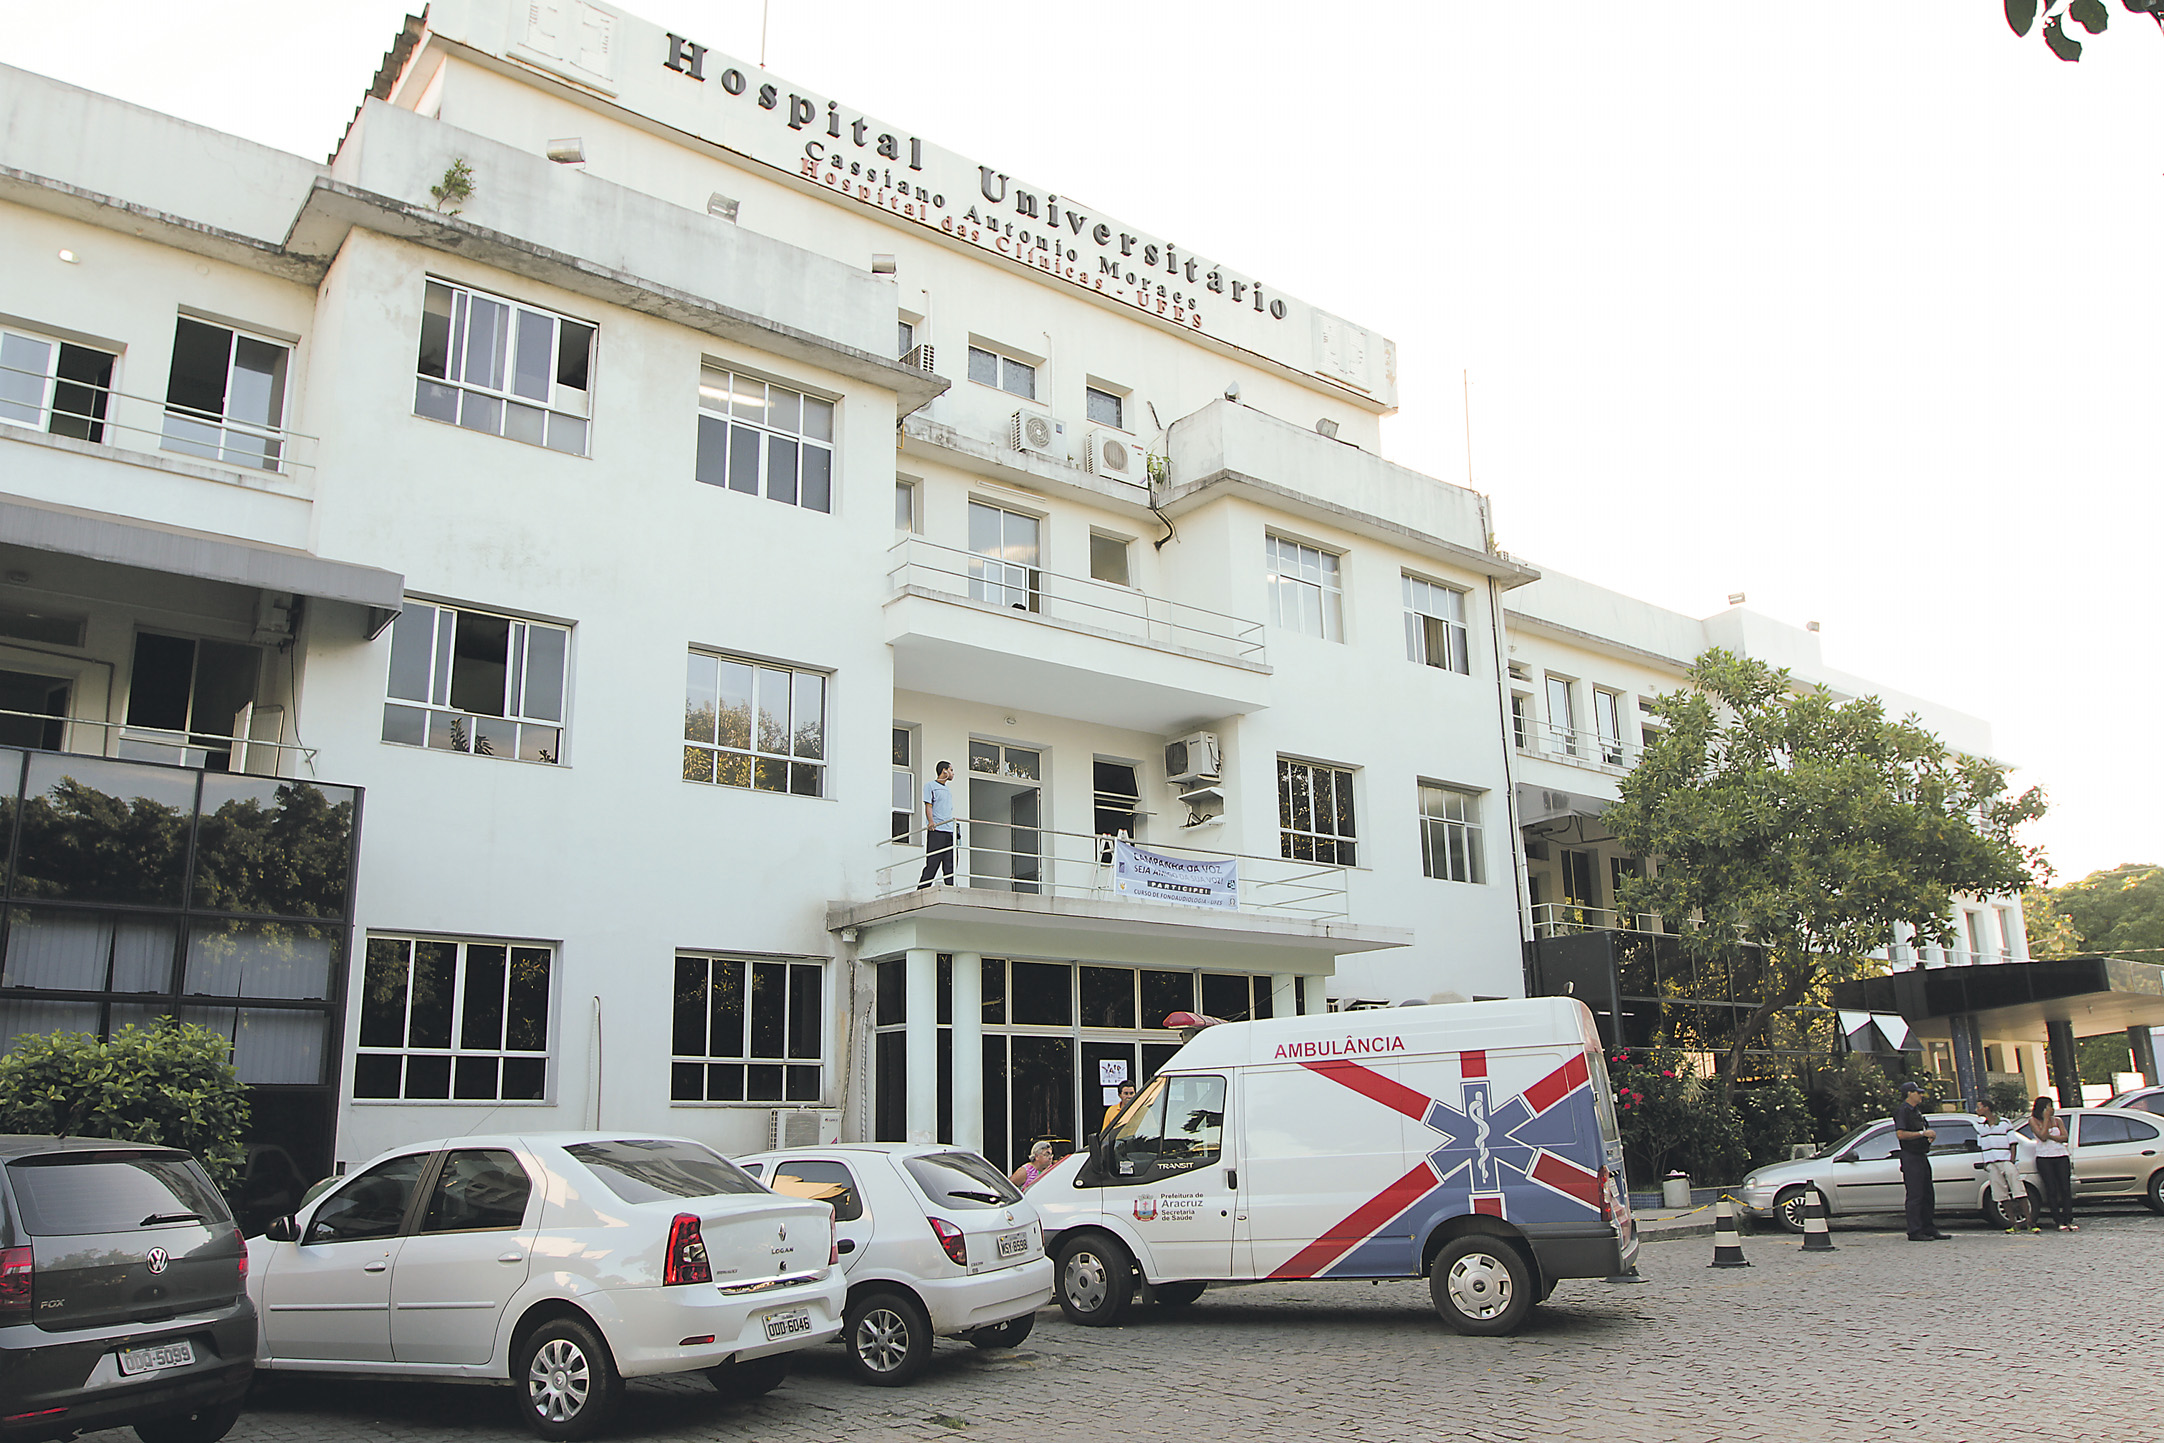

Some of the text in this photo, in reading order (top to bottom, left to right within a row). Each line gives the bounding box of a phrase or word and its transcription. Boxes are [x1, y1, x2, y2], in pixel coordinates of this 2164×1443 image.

[663, 32, 1287, 320] Hospital Universitário
[805, 140, 1196, 310] Cassiano Antonio Moraes
[800, 157, 926, 221] Hospital
[941, 216, 980, 242] das
[995, 236, 1103, 289] Clínicas
[1136, 290, 1202, 328] UFES
[1133, 852, 1222, 874] CAMPANHA DA VOZ
[1134, 864, 1151, 874] SEJA
[1190, 874, 1206, 883] SUA
[1134, 888, 1151, 897] CURSO
[1160, 893, 1206, 904] FONOAUDIOLOGIA
[1274, 1035, 1405, 1059] AMBULÂNCIA
[1157, 1162, 1194, 1170] TRANSIT
[1161, 1199, 1204, 1208] Aracruz
[40, 1299, 65, 1309] FOX
